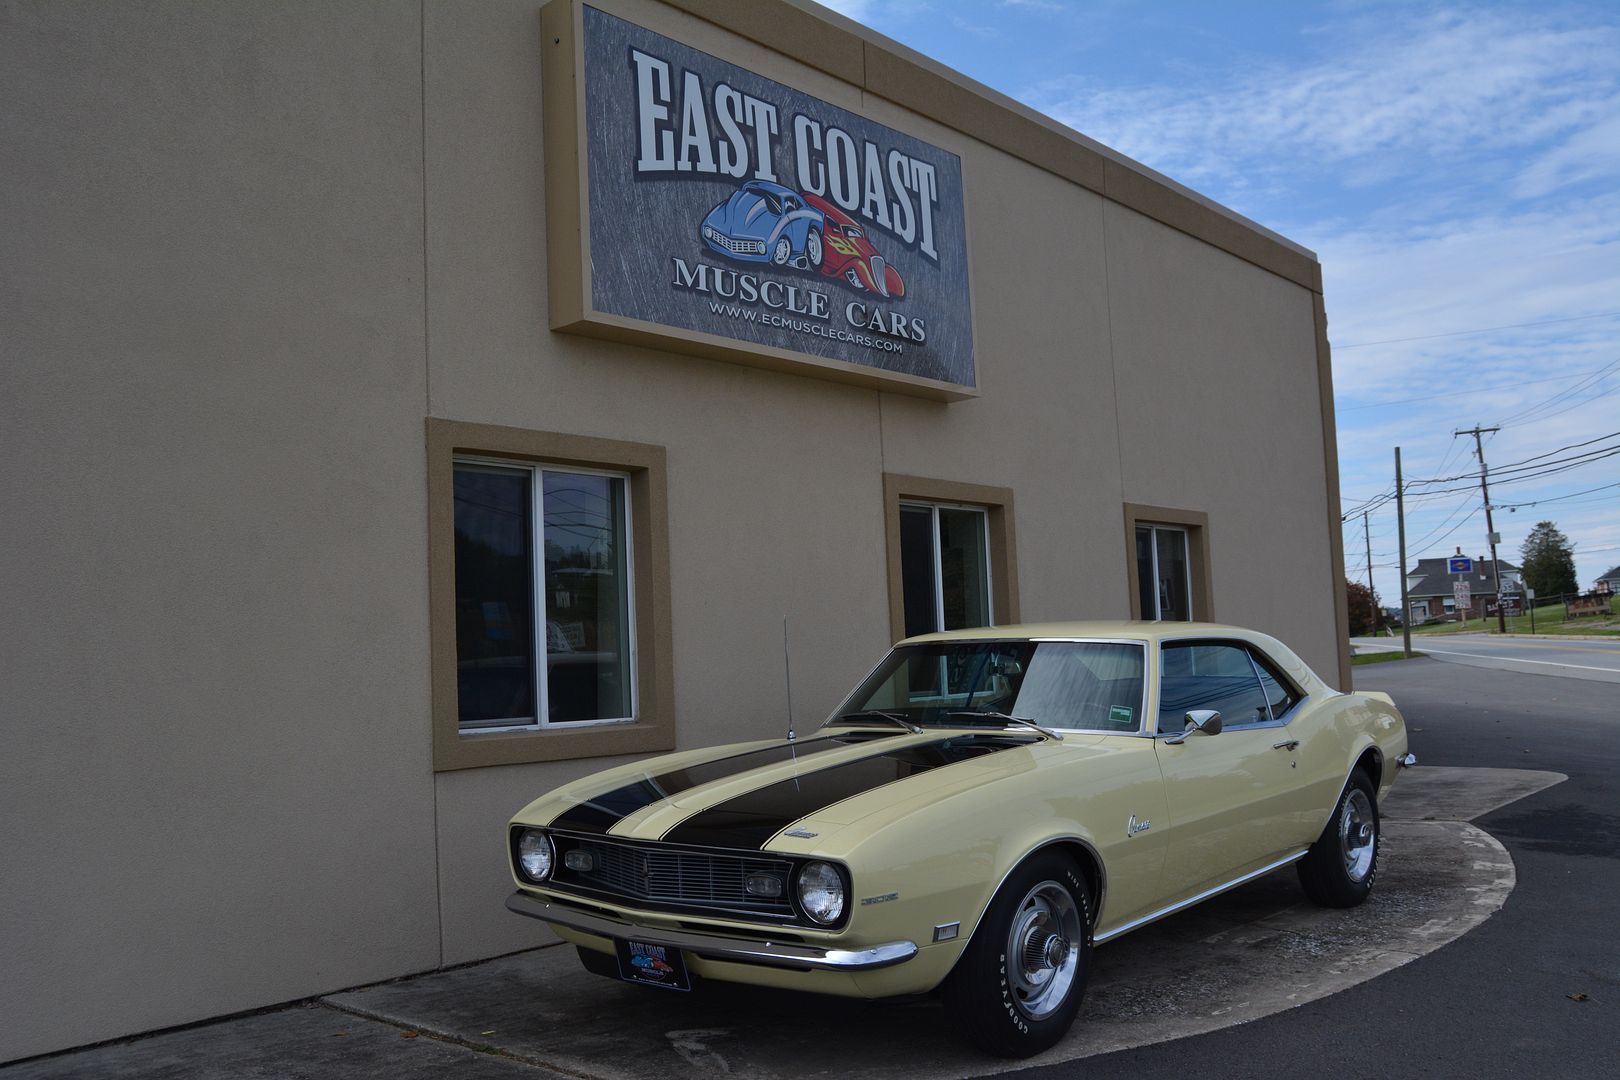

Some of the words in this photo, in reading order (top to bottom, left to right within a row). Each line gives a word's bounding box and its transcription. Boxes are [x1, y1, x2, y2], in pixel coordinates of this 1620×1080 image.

[632, 49, 778, 182] EAST
[794, 114, 938, 261] COAST
[672, 257, 830, 320] MUSCLE
[845, 302, 926, 342] CARS
[709, 302, 904, 354] WWW.ECMUSCLECARS.COM
[999, 953, 1029, 1034] GOODYEAR
